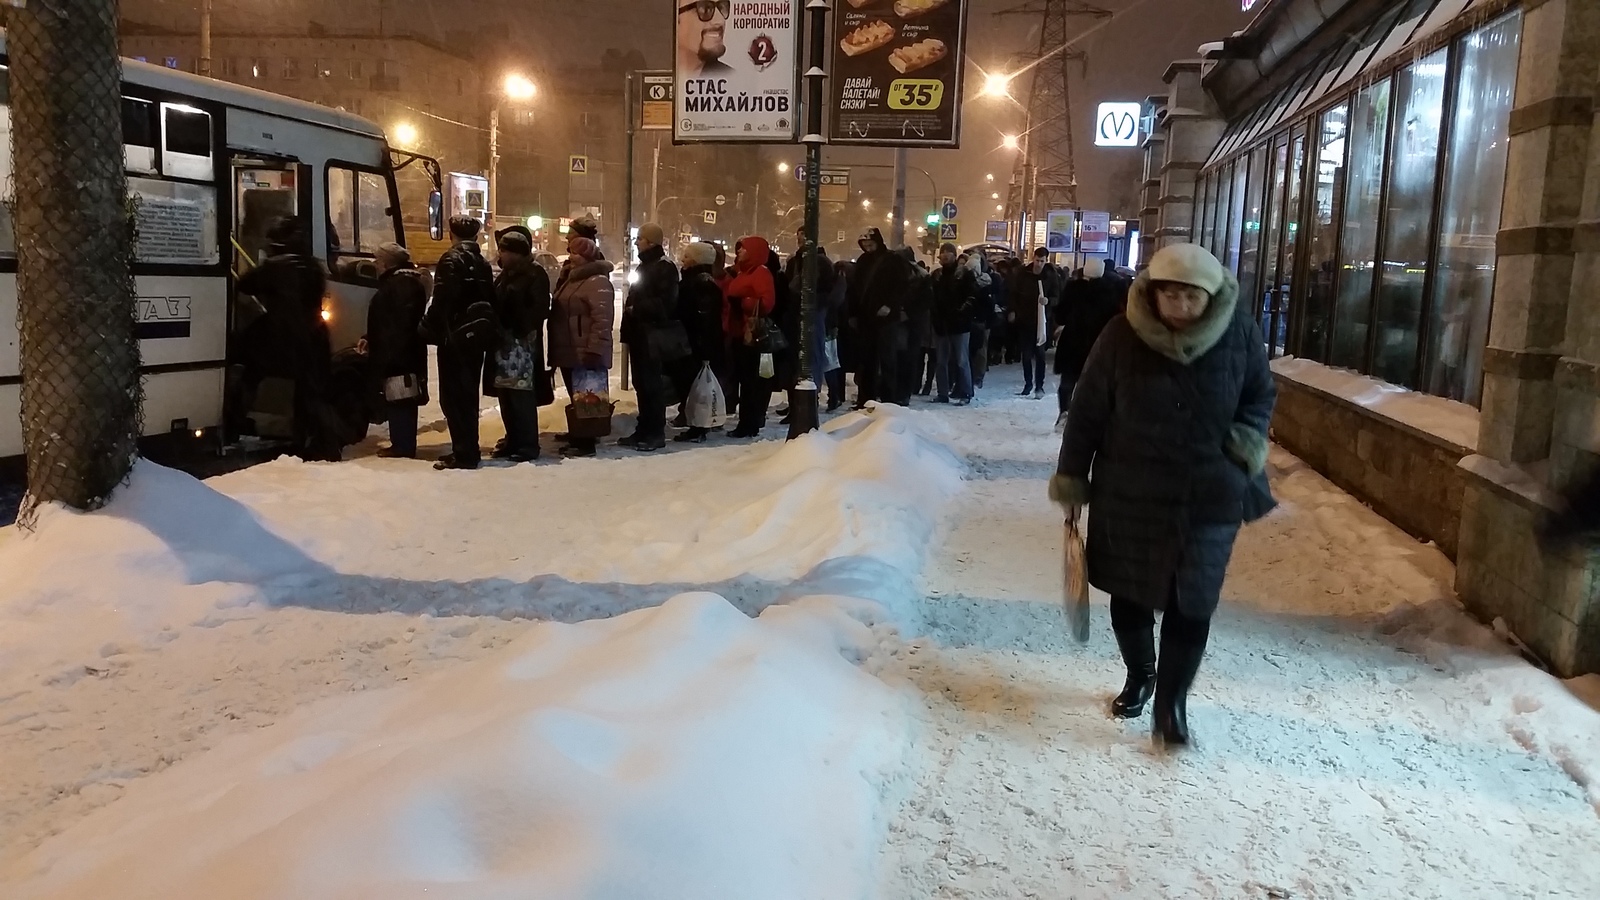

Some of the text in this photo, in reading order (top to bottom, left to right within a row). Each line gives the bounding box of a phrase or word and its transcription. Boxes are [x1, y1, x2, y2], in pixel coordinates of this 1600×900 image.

[733, 0, 790, 17] НАРОДНЫЙ
[733, 17, 790, 29] КОРПОРАТИВ
[902, 23, 929, 31] Ветчина
[758, 41, 767, 61] 2
[685, 79, 727, 95] СТАС
[843, 76, 872, 89] ДАВАЙ
[841, 87, 881, 99] НАЛЕТАЙ!
[685, 92, 789, 112] МИХАЙЛОВ
[840, 99, 866, 110] СНЭКИ
